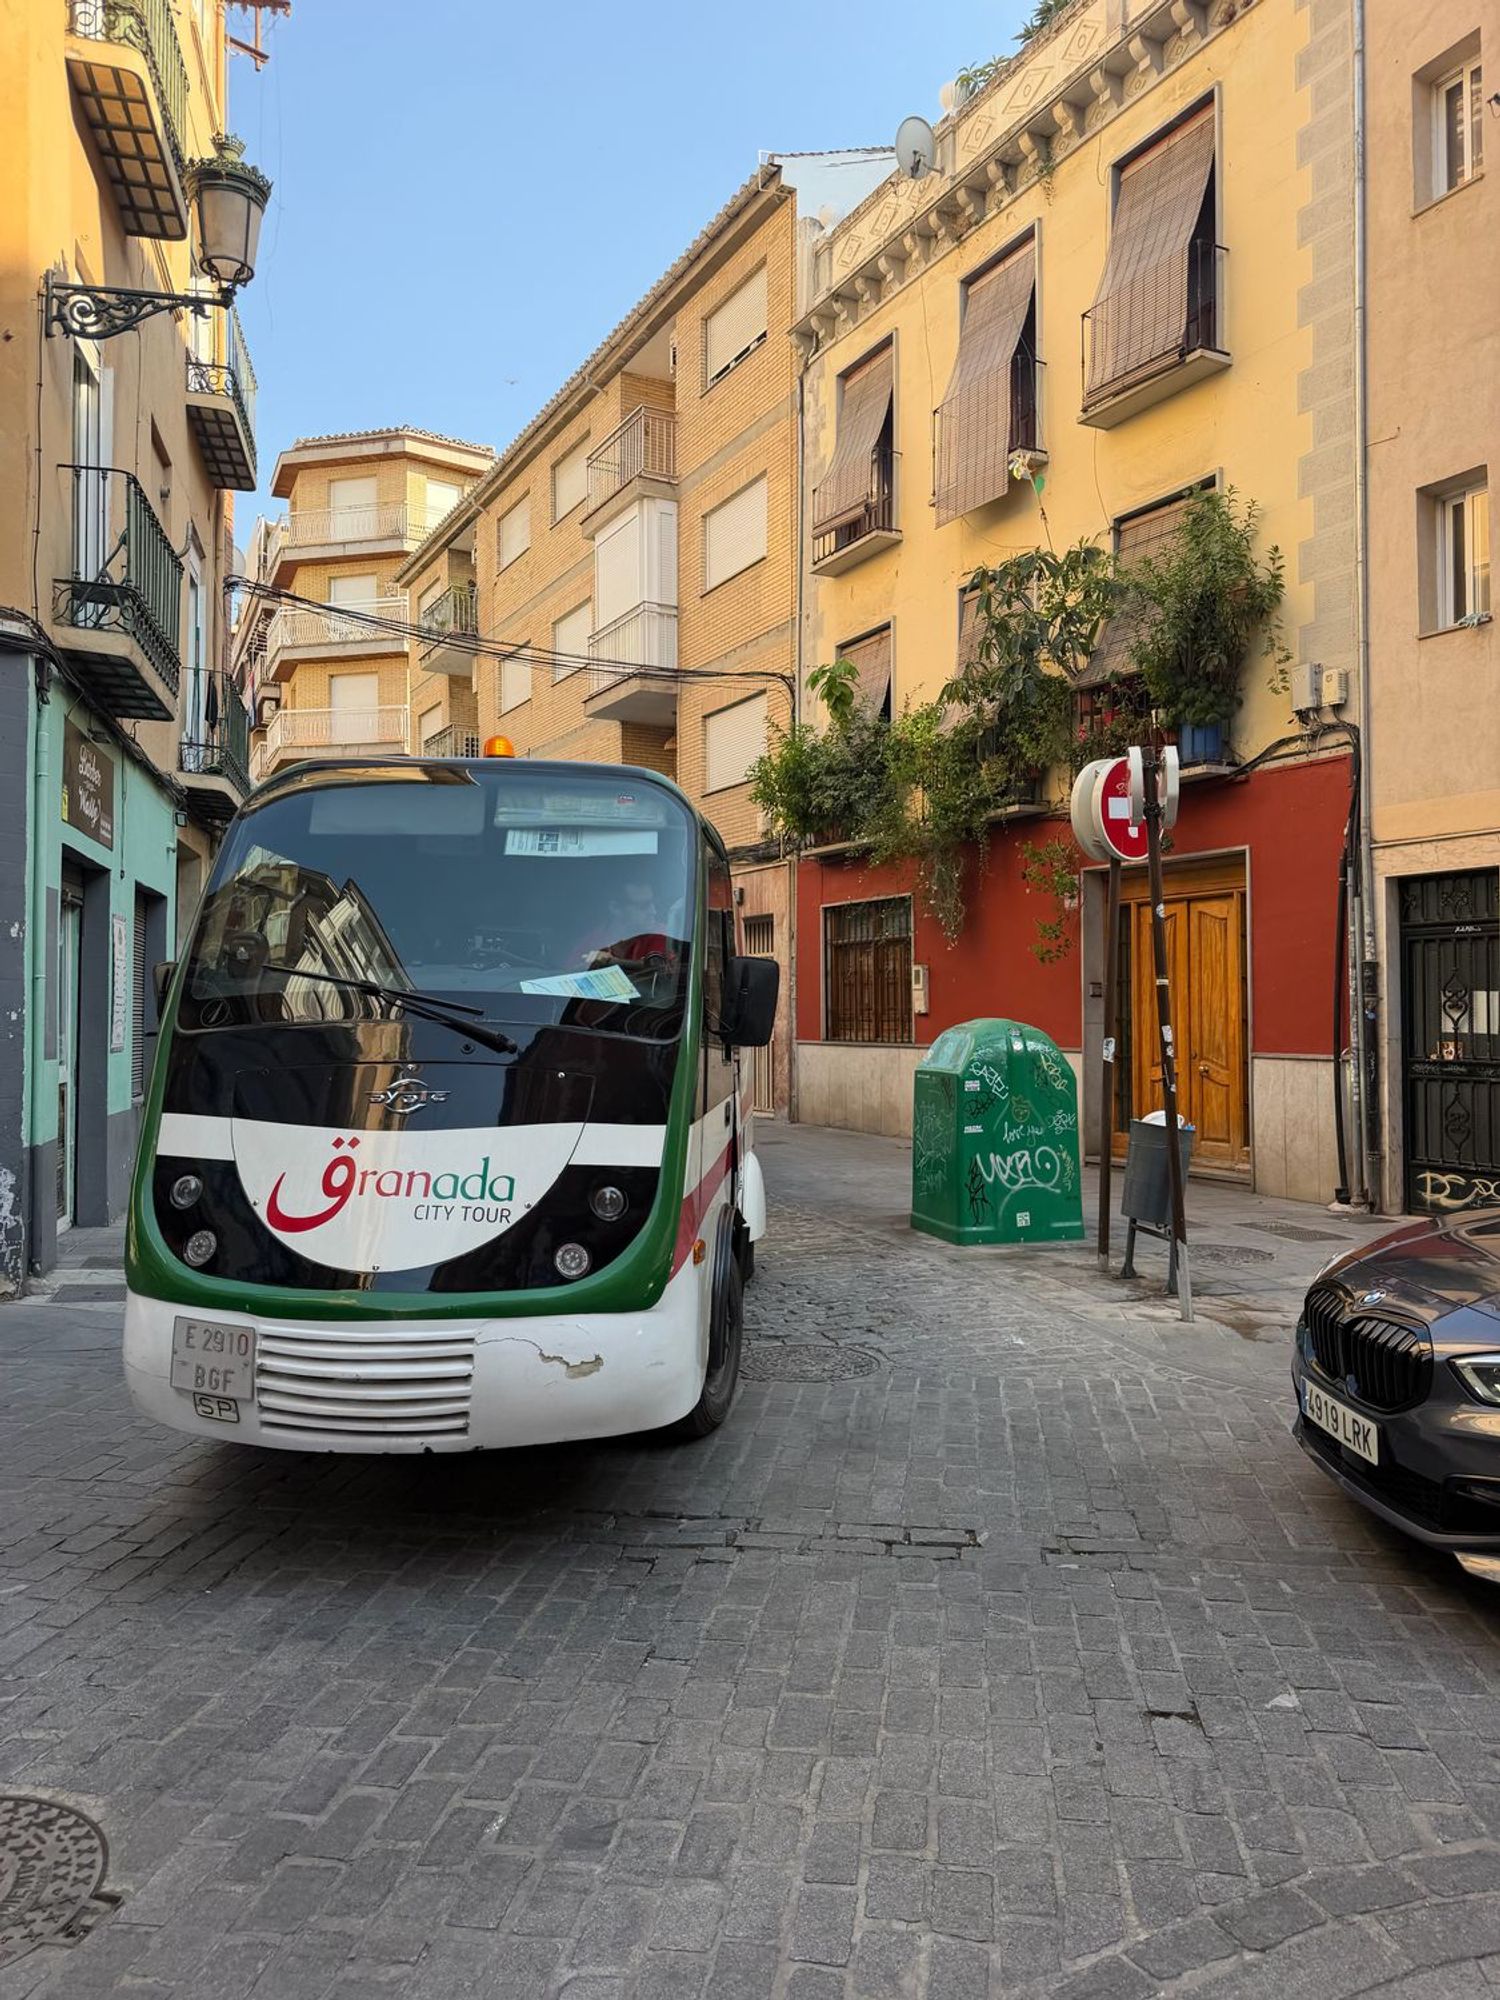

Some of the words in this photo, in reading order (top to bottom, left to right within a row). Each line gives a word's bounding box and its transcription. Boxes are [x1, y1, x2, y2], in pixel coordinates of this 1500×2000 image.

[414, 1204, 455, 1221] CITY
[461, 1205, 511, 1224] TOUR
[202, 1328, 249, 1357] 2910
[198, 1396, 232, 1417] SP
[1308, 1388, 1339, 1433] 4919
[1342, 1412, 1372, 1457] LRK
